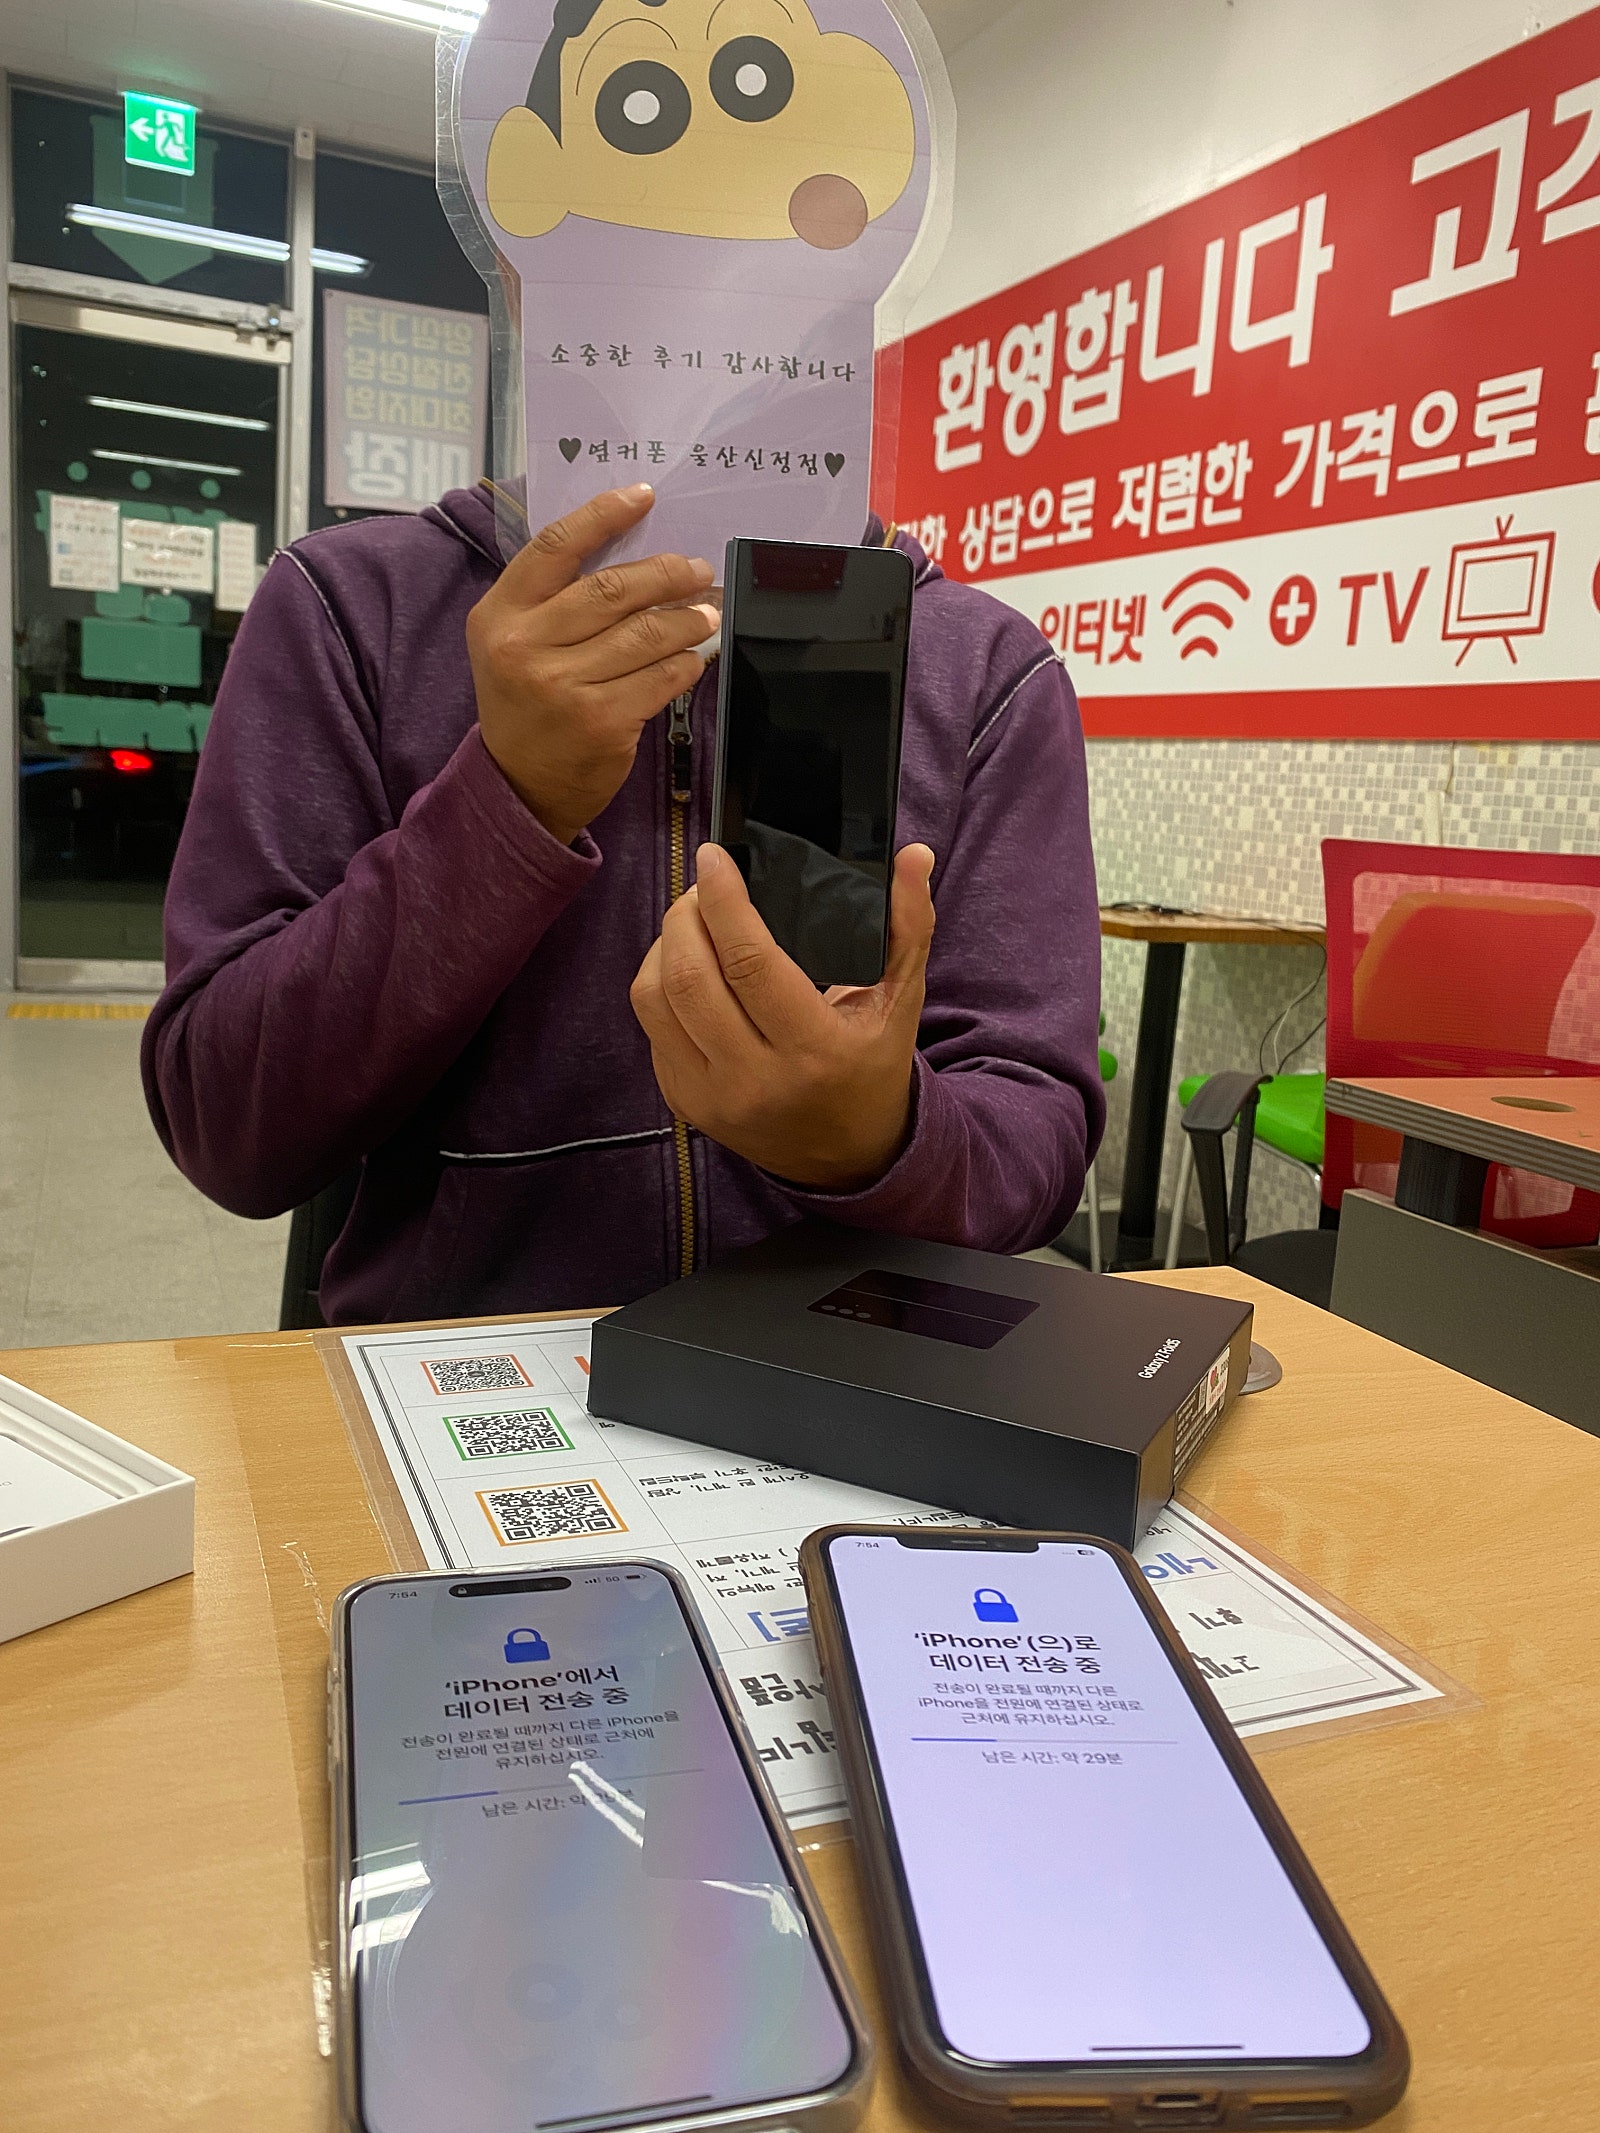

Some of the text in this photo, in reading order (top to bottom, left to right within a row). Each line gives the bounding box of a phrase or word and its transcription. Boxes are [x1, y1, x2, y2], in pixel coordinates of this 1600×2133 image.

[933, 192, 1335, 472] 환영합니다
[551, 343, 856, 382] 소중한 후기 감사합니다
[958, 477, 1096, 573] 상담으로
[1111, 439, 1254, 538] 저렴한
[1275, 366, 1543, 509] 가격으로
[1339, 566, 1430, 646] TV
[1138, 1356, 1169, 1379] Galaxy
[855, 1541, 880, 1549] 7:54
[388, 1590, 418, 1600] 7:54
[929, 1653, 1101, 1674] 데이터 전송 중
[933, 1682, 1118, 1697] 전송이 완료될 때까지 다른
[444, 1686, 630, 1720] 데이터 전송 중
[918, 1697, 1144, 1712] iPhone을 전원에 연결된 상태로
[401, 1710, 681, 1749] 전송이 완료될 때까지 다른 iPhone을
[962, 1712, 1115, 1726] 근처에 유지하십시오.
[435, 1727, 655, 1761] 전원에 연결된 상태로 근처에
[495, 1749, 605, 1770] 유지하십시오.
[981, 1751, 1017, 1764] 남은
[1062, 1752, 1079, 1764] 약
[1083, 1752, 1124, 1765] 29분
[481, 1802, 520, 1818] 남은
